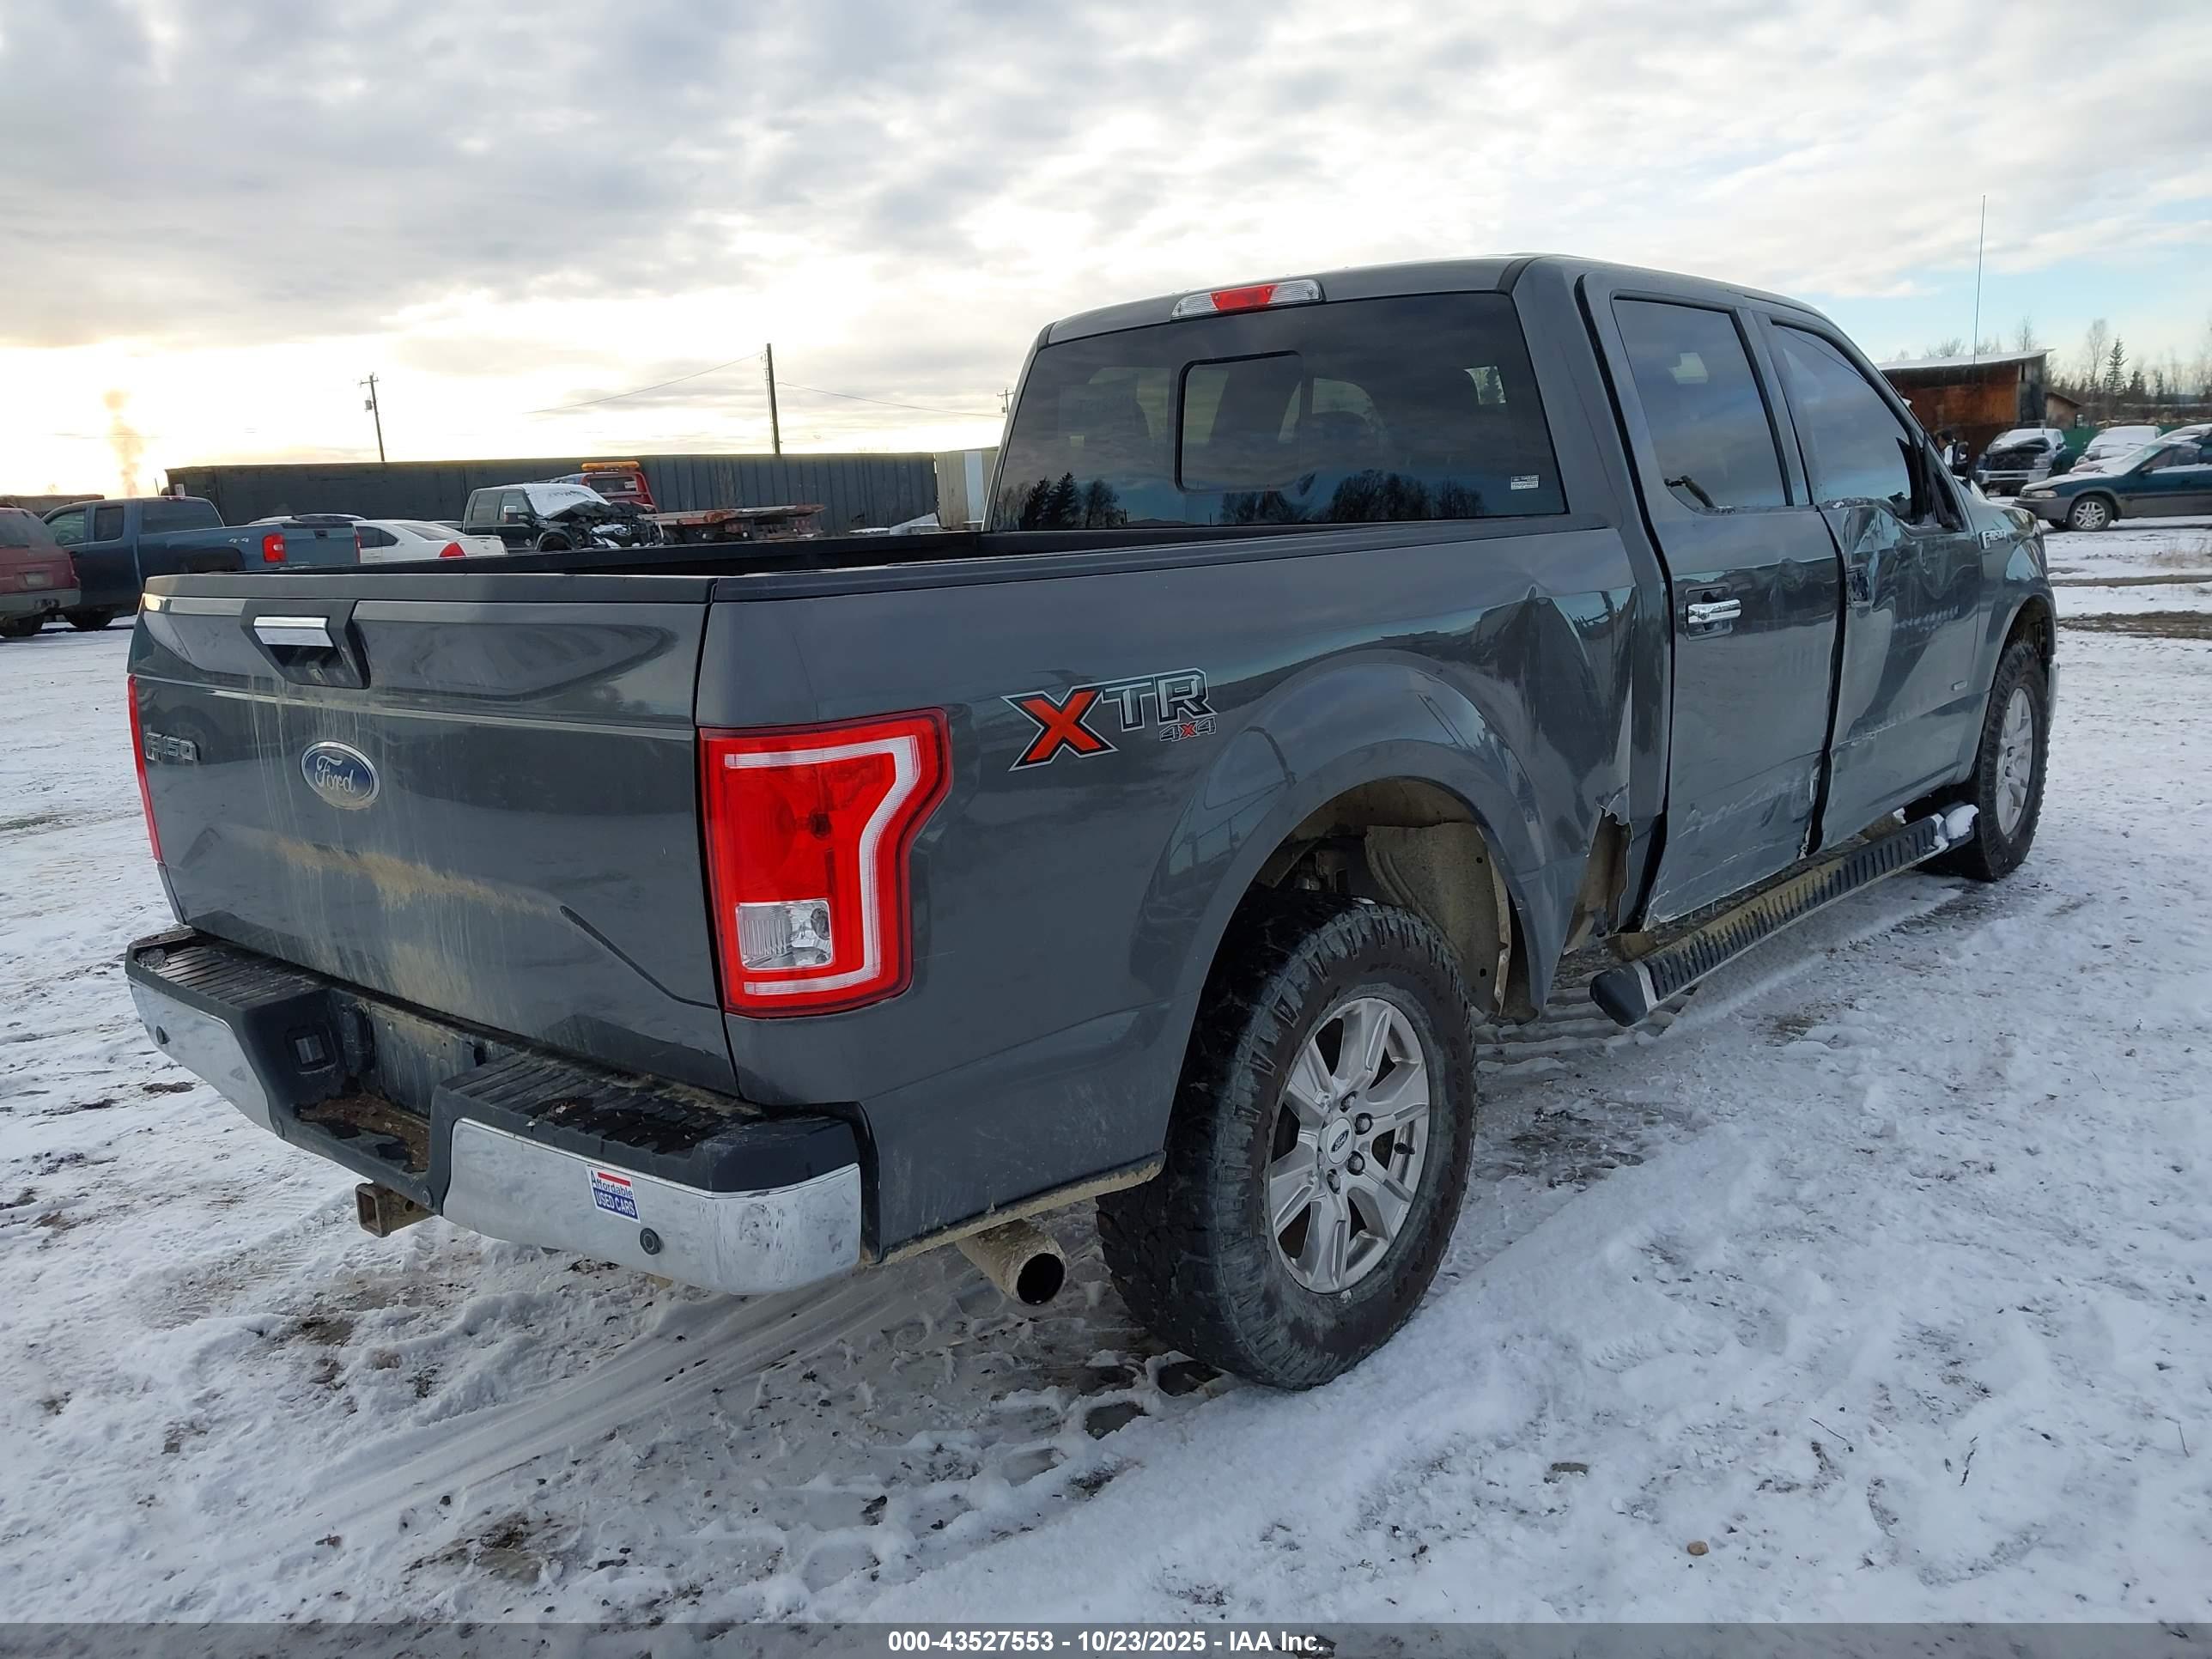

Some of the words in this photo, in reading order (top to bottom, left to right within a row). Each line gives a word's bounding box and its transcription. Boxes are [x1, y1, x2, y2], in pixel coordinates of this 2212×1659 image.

[1000, 667, 1218, 772] XTR
[314, 755, 357, 793] Ford
[590, 1170, 634, 1199] Affordable
[595, 1190, 615, 1210] USED
[614, 1196, 635, 1217] CARS
